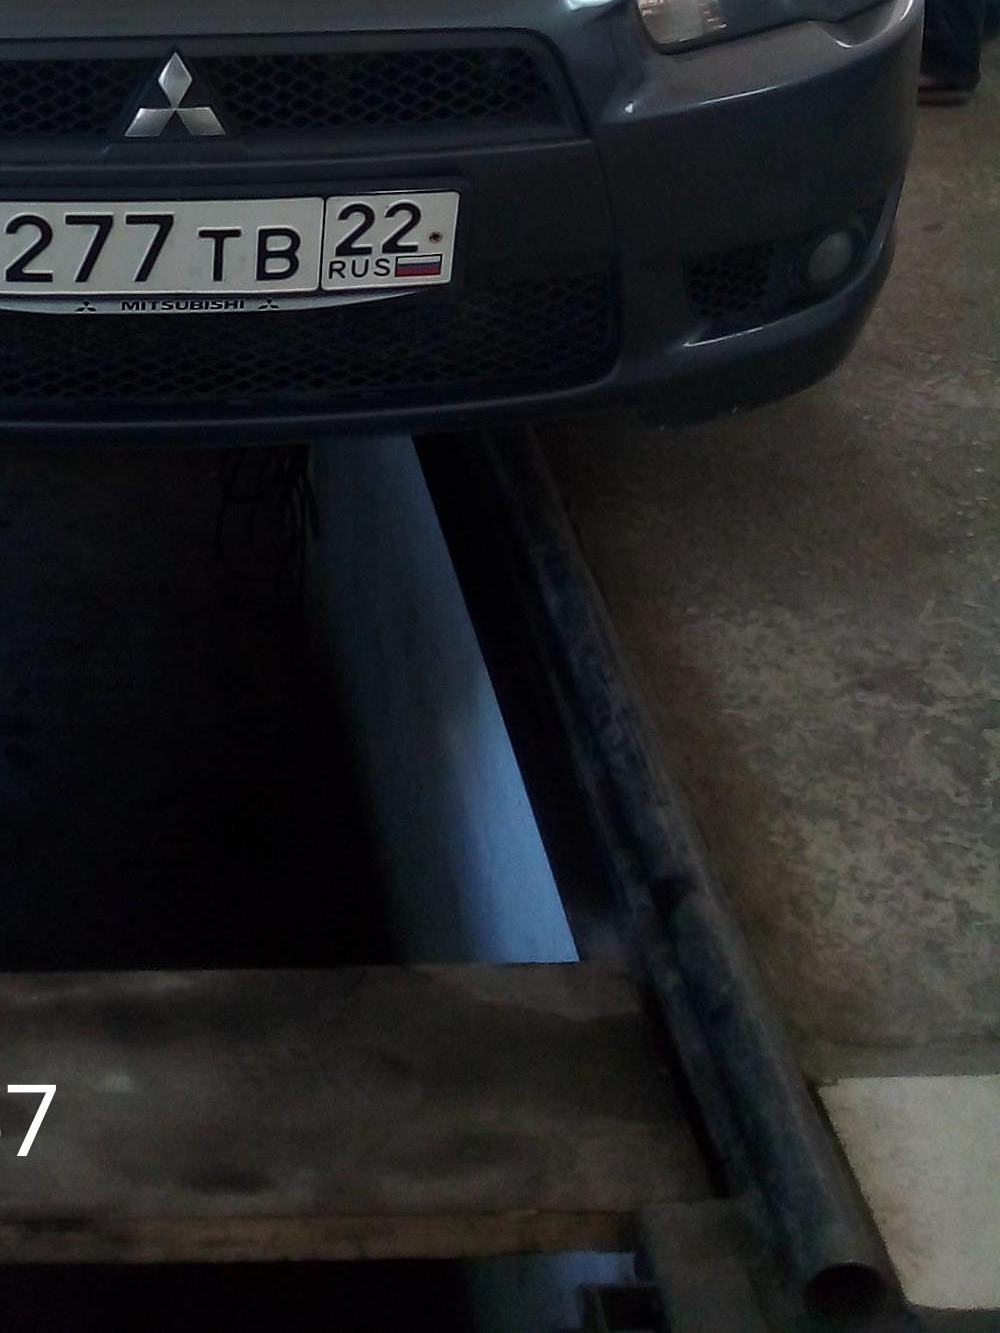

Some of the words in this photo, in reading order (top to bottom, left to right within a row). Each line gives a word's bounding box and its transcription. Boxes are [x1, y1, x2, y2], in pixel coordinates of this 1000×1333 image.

[334, 202, 422, 258] 22
[328, 258, 391, 280] RUS
[120, 299, 245, 311] MITSUBISHI
